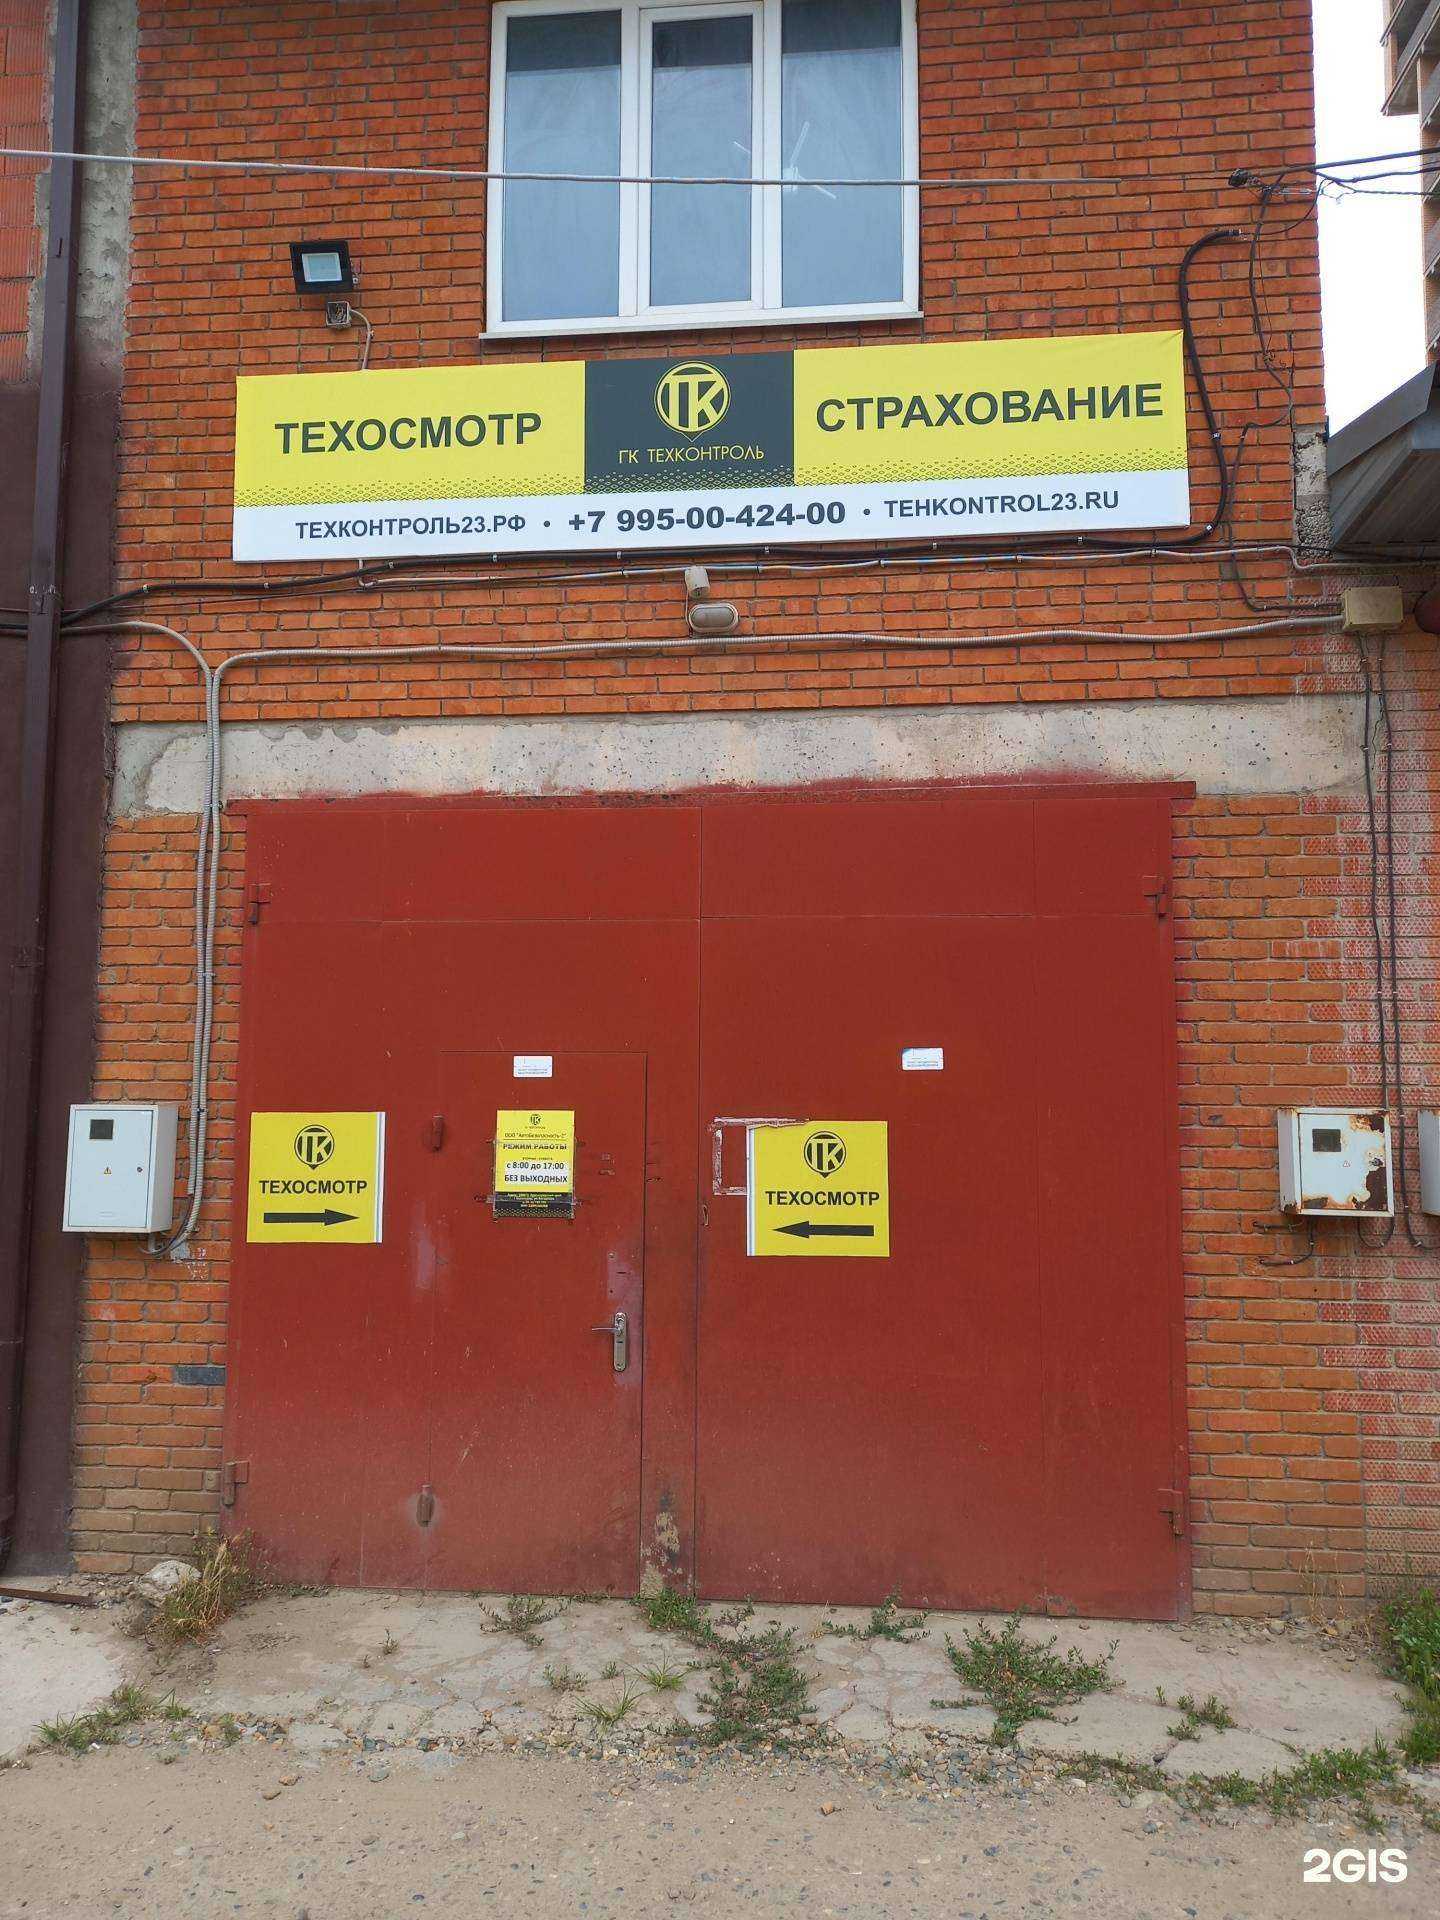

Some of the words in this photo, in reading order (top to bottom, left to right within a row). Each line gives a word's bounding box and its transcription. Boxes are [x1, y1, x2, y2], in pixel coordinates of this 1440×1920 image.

[816, 382, 1164, 433] СТРАХОВАНИЕ
[274, 412, 542, 455] ТЕХОСМОТР
[618, 449, 640, 464] ГК
[647, 445, 765, 463] ТЕХКОНТРОЛЬ
[884, 490, 1120, 518] TEHKONTROL23.RU
[295, 514, 527, 540] ТЕХКОНТРОЛЬ23.РФ
[568, 510, 607, 533] +7
[616, 501, 846, 532] 995-00-424-00
[543, 1162, 565, 1170] 17:00
[259, 1180, 368, 1194] ТЕХОСМОТР
[504, 1174, 518, 1182] БЕЗ
[520, 1175, 568, 1183] ВЫХОДНЫХ
[765, 1190, 880, 1206] ТЕХОСМОТР
